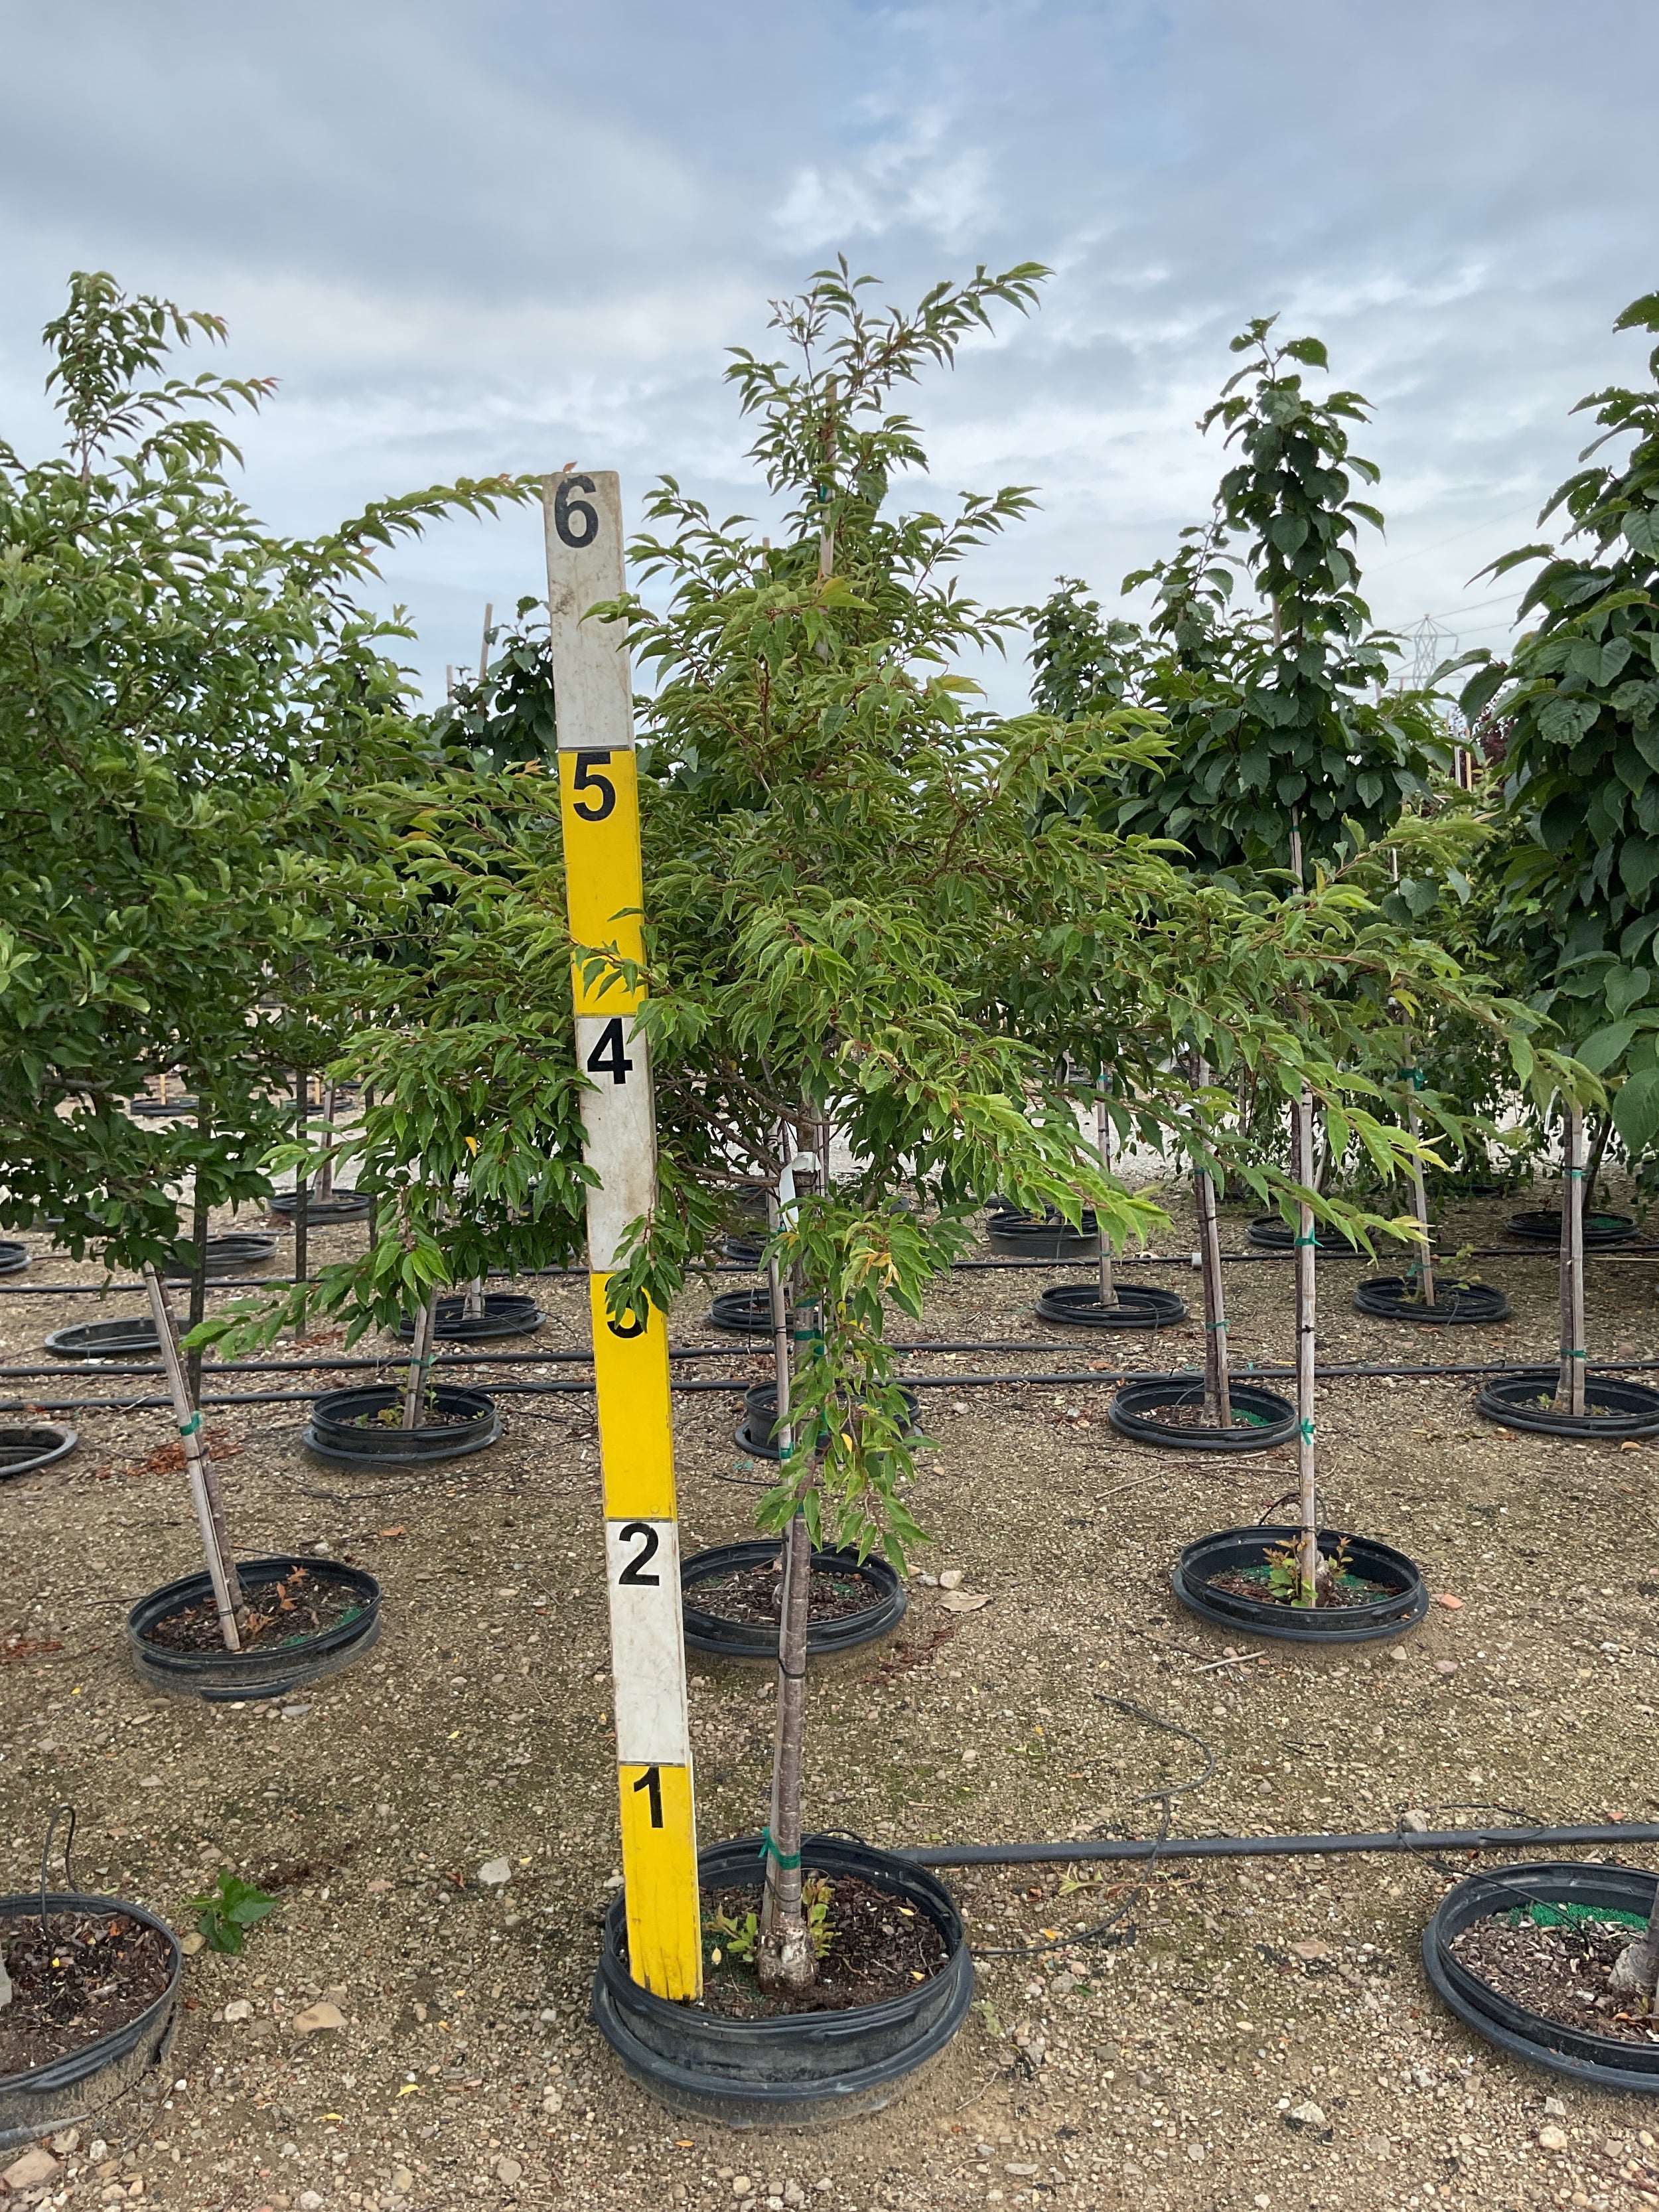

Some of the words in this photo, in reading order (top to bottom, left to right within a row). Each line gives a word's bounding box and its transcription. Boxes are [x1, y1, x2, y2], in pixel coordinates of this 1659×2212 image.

[555, 475, 599, 548] 6
[573, 751, 616, 822] 5
[587, 1017, 633, 1085] 4
[618, 1522, 660, 1586] 2
[633, 1767, 663, 1828] 1
